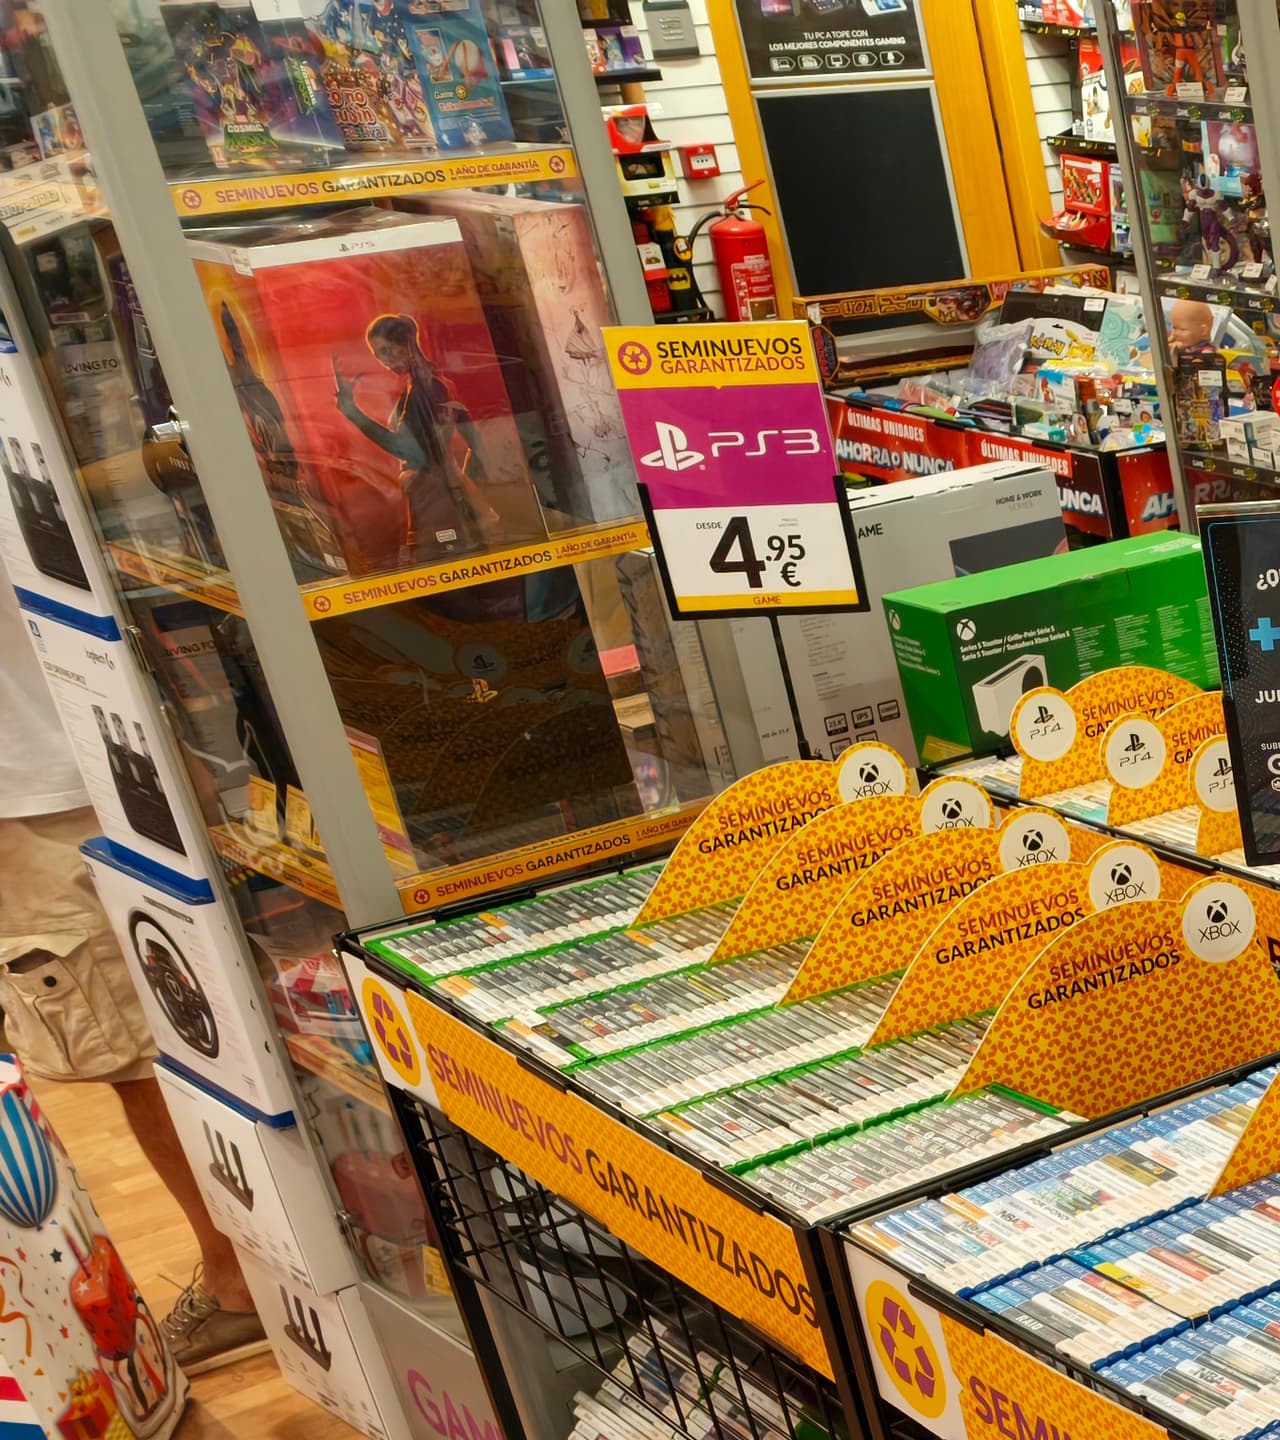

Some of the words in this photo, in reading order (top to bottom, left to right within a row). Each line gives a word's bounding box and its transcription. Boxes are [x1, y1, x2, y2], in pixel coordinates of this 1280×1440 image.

[769, 43, 783, 51] LOS
[784, 41, 817, 50] MEJORES
[819, 38, 874, 49] COMPONENTES
[875, 37, 906, 46] GAMING
[215, 181, 319, 204] SEMINUEVOS
[322, 170, 446, 193] GARANTIZADOS
[656, 338, 802, 359] SEMINUEVOS
[660, 356, 805, 374] GARANTIZADOS
[708, 428, 820, 457] PS3
[848, 409, 882, 431] ÚLTIMAS
[885, 418, 924, 442] UNIDADES
[836, 439, 891, 465] AHORRA
[903, 451, 955, 474] NUNCA
[696, 522, 722, 530] DESDE
[343, 575, 438, 605] SEMINUEVOS
[439, 549, 553, 584] GARANTIZADOS
[753, 596, 781, 604] GAME
[1082, 687, 1175, 722] SEMINUEVOS
[436, 861, 523, 898] SEMINUEVOS
[525, 833, 631, 872] GARANTIZADOS
[956, 888, 1080, 939] SEMINUEVOS
[1198, 917, 1243, 942] XBOX
[935, 906, 1086, 966] GARANTIZADOS
[1048, 931, 1175, 983] SEMINUEVOS
[1026, 948, 1182, 1011] GARANTIZADOS
[426, 1042, 584, 1177] SEMINUEVOS
[584, 1147, 820, 1330] GARANTIZADOS
